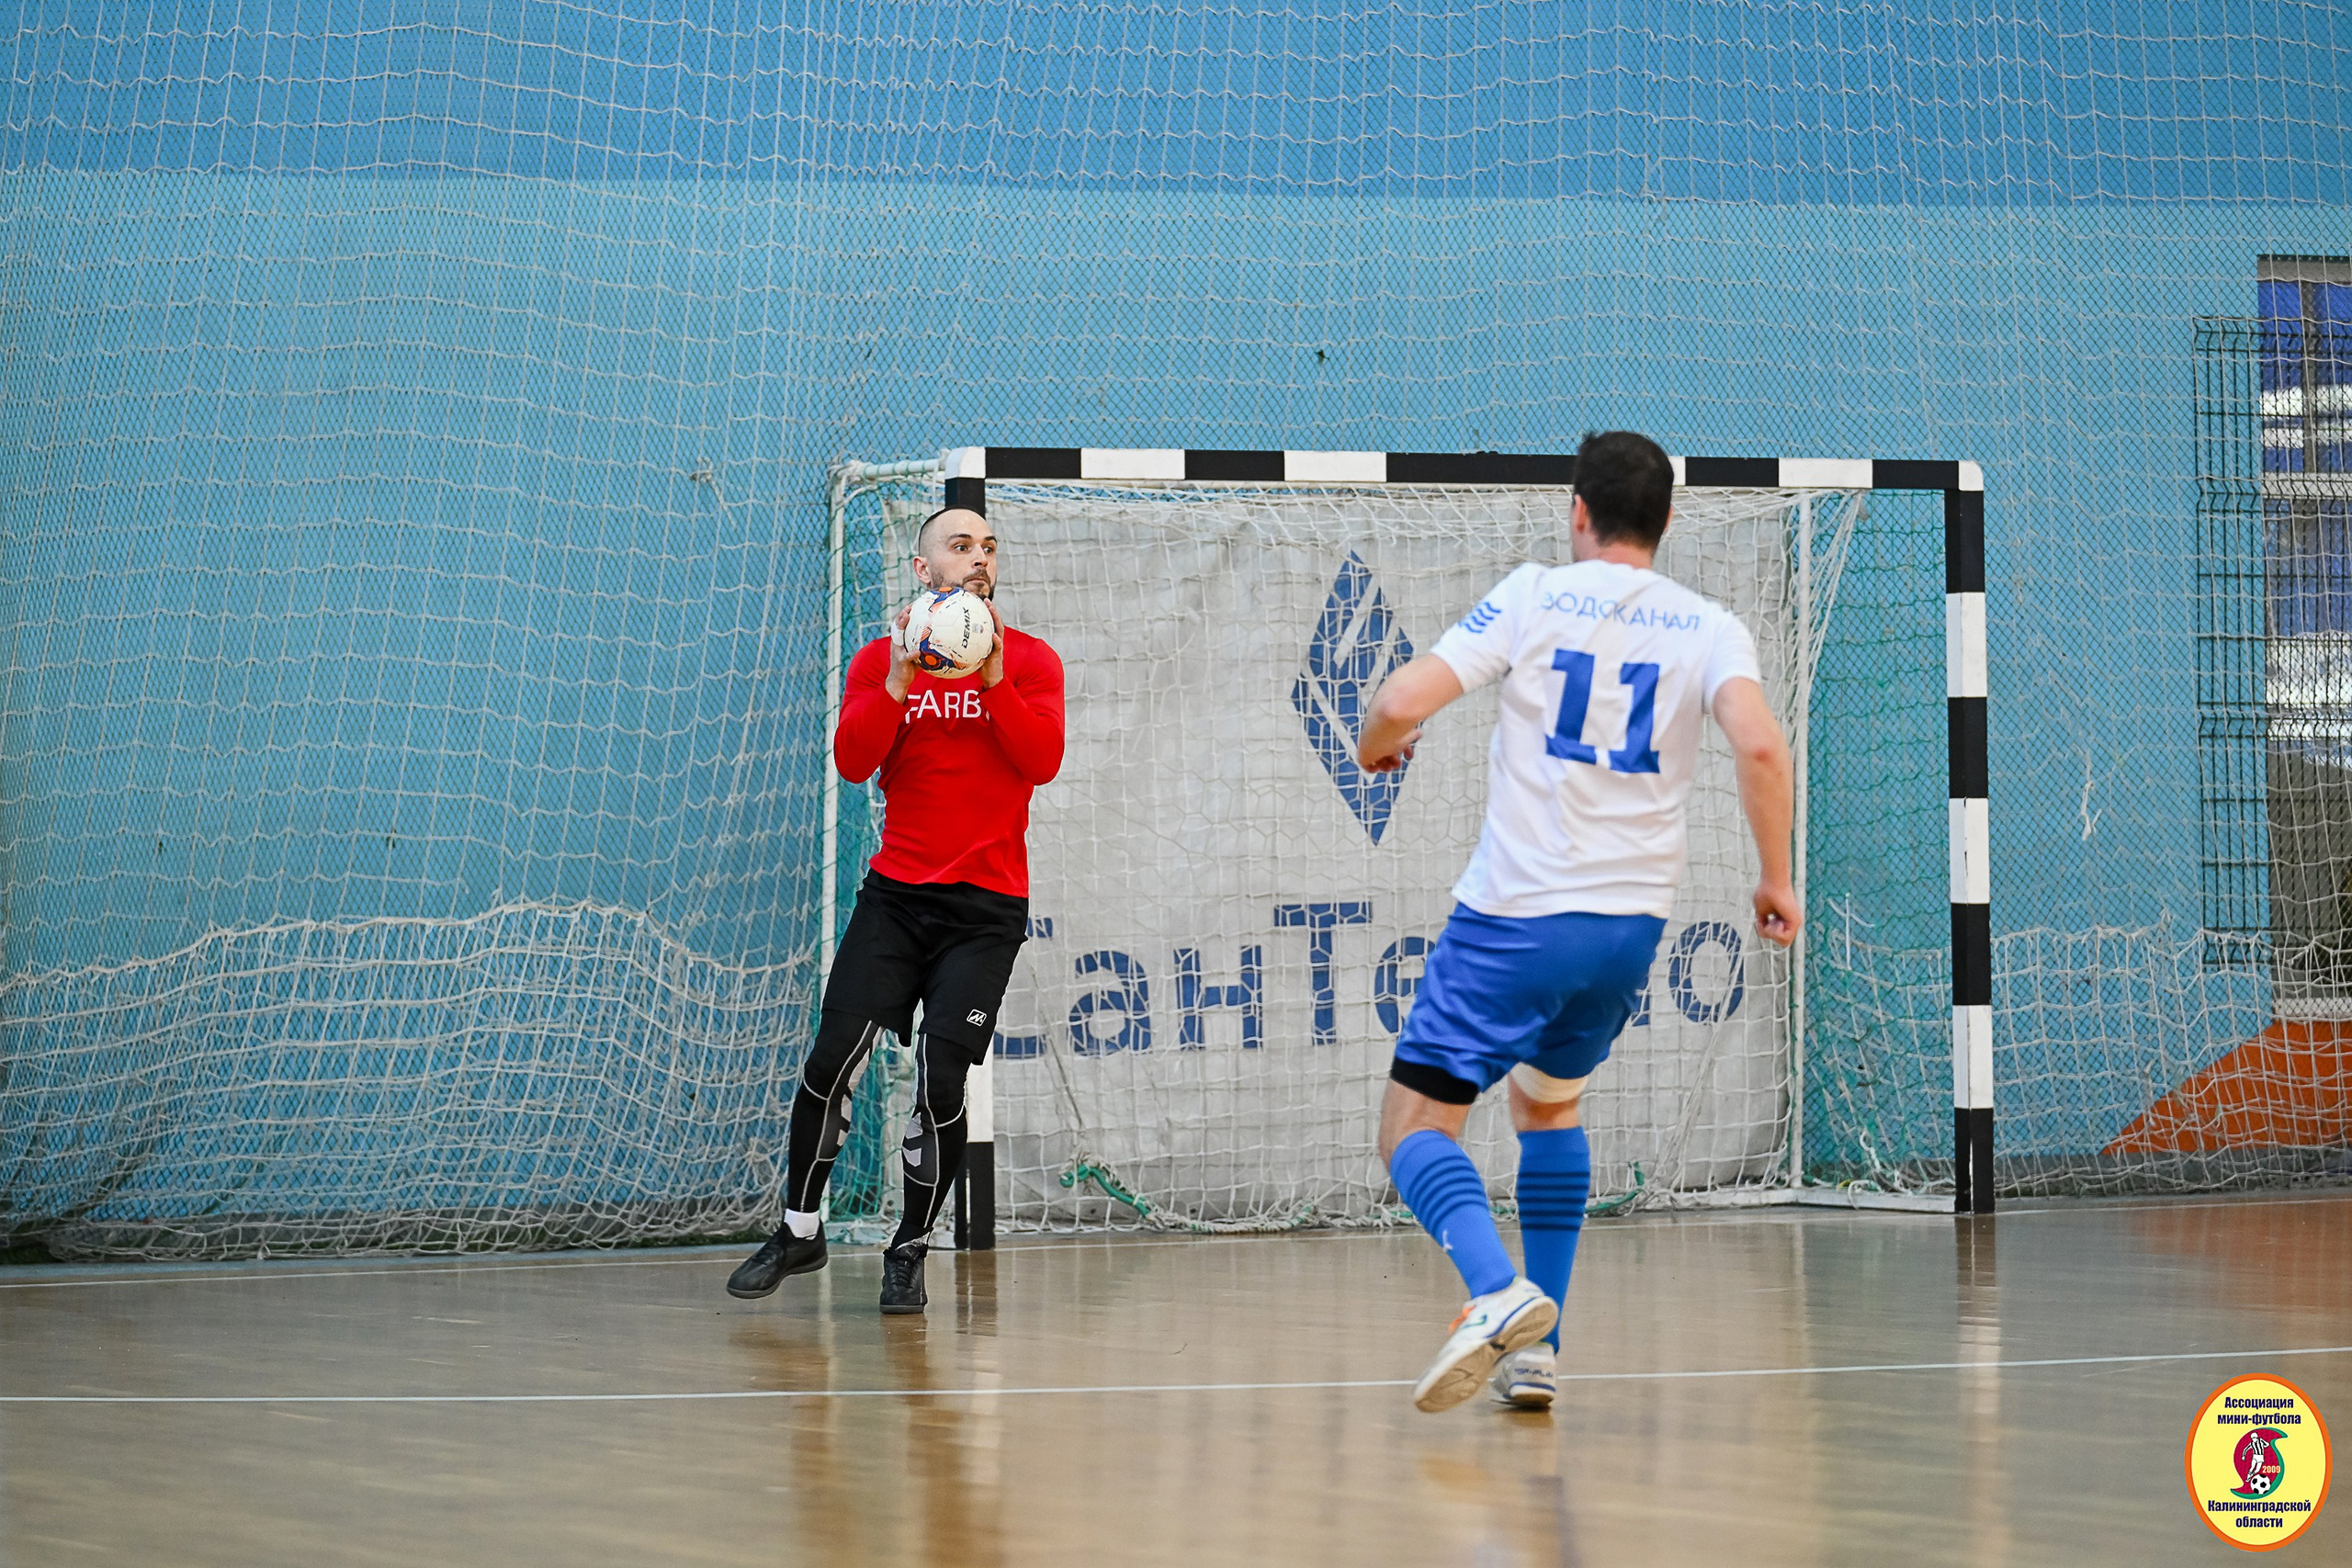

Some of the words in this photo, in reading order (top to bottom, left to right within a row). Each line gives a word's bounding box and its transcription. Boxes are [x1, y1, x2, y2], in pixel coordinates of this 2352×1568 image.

[961, 606, 971, 649] DEMIX
[904, 689, 990, 725] FARB
[1545, 649, 1660, 773] 11
